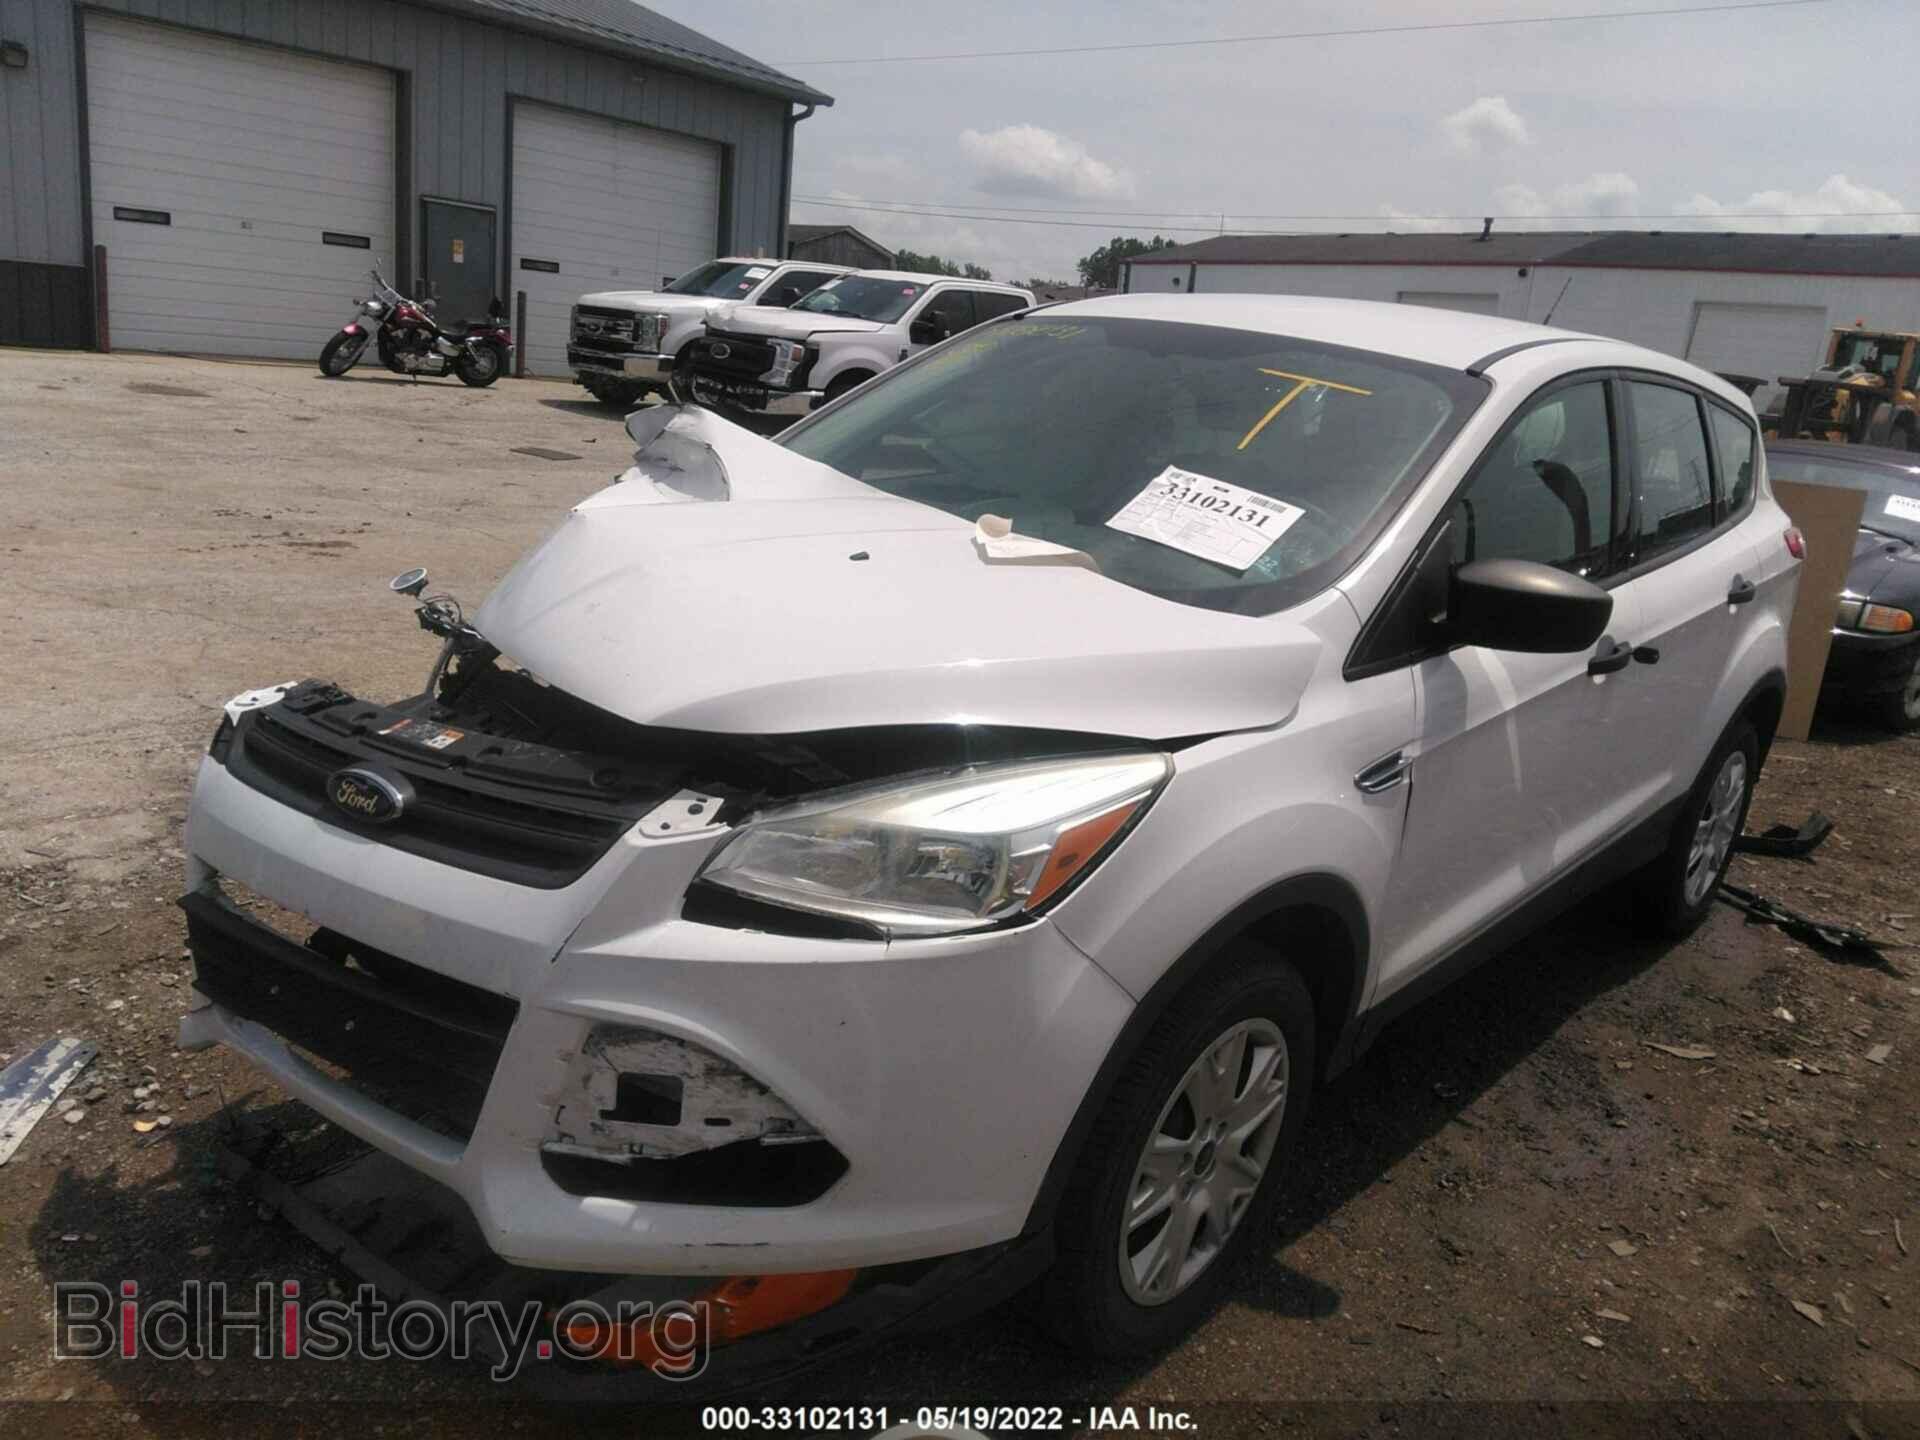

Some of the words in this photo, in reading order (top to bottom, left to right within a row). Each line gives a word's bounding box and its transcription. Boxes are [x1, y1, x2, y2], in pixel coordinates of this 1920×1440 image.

[1236, 367, 1374, 450] T
[1160, 482, 1271, 528] 33102131
[337, 780, 378, 814] Ford
